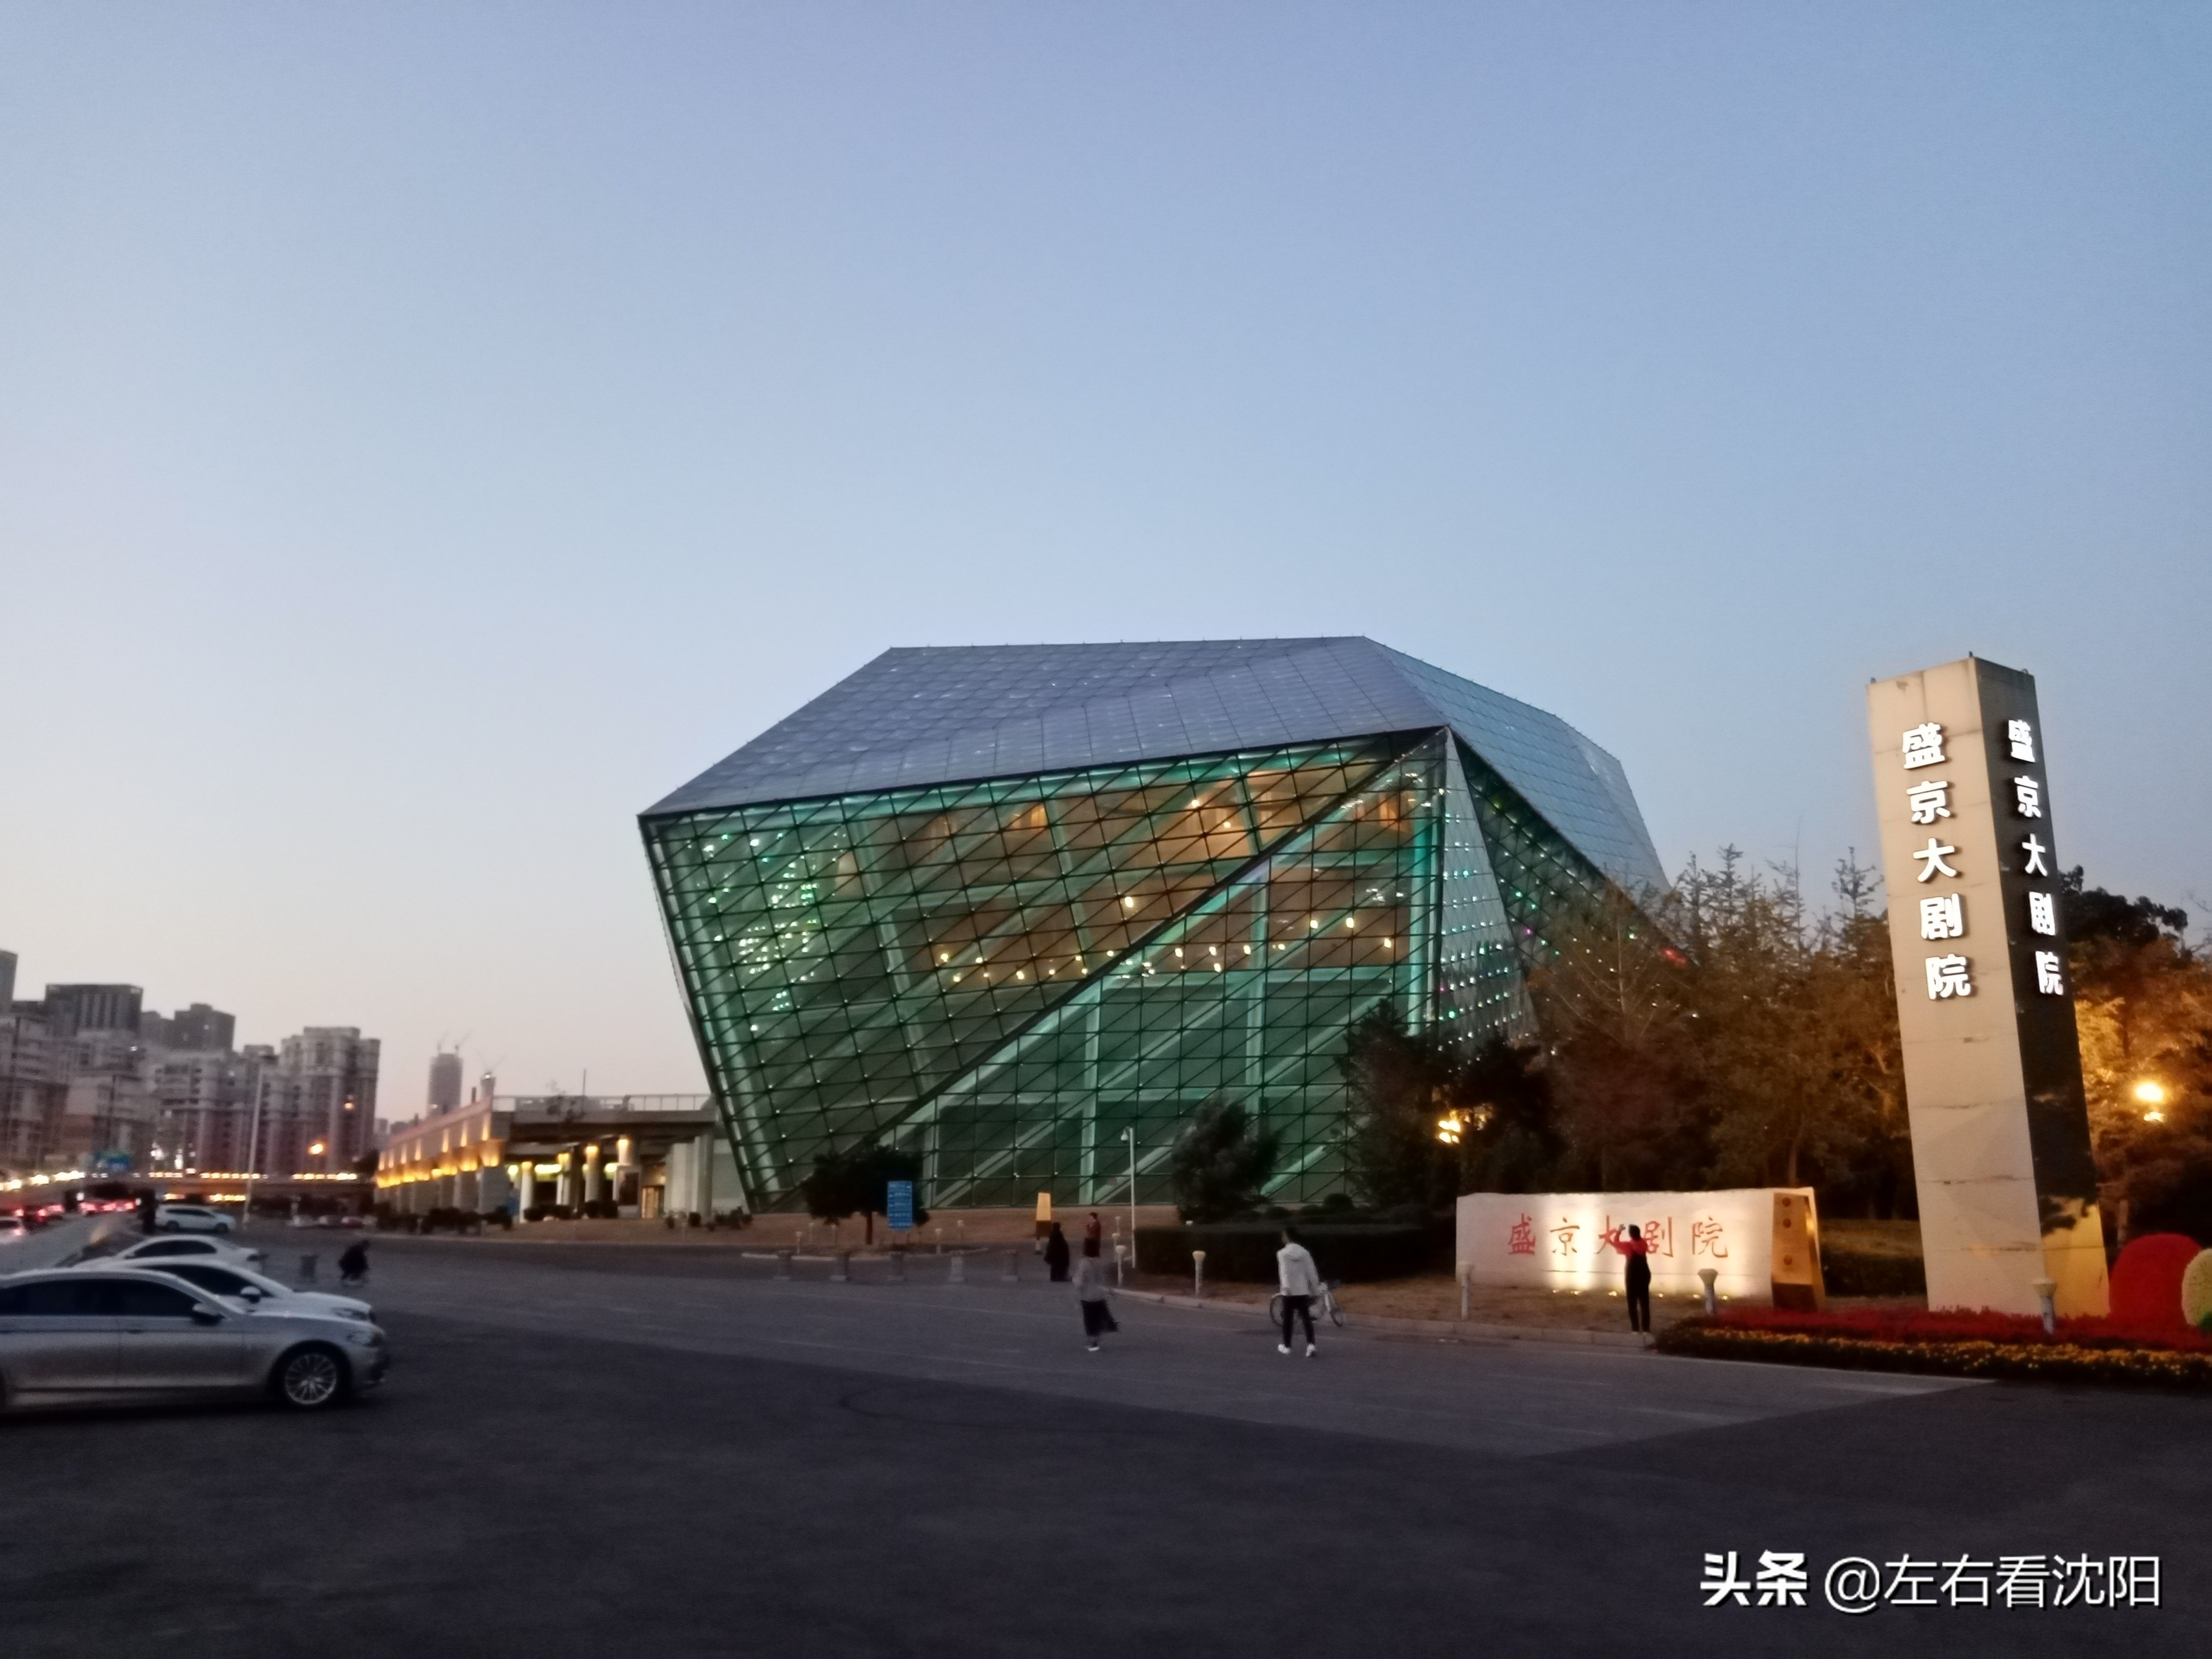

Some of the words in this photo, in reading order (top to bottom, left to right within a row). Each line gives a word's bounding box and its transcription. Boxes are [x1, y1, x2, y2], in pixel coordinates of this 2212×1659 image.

[1902, 722, 1972, 1000] 盛京大剧院
[2008, 719, 2064, 996] 盛京大剧院
